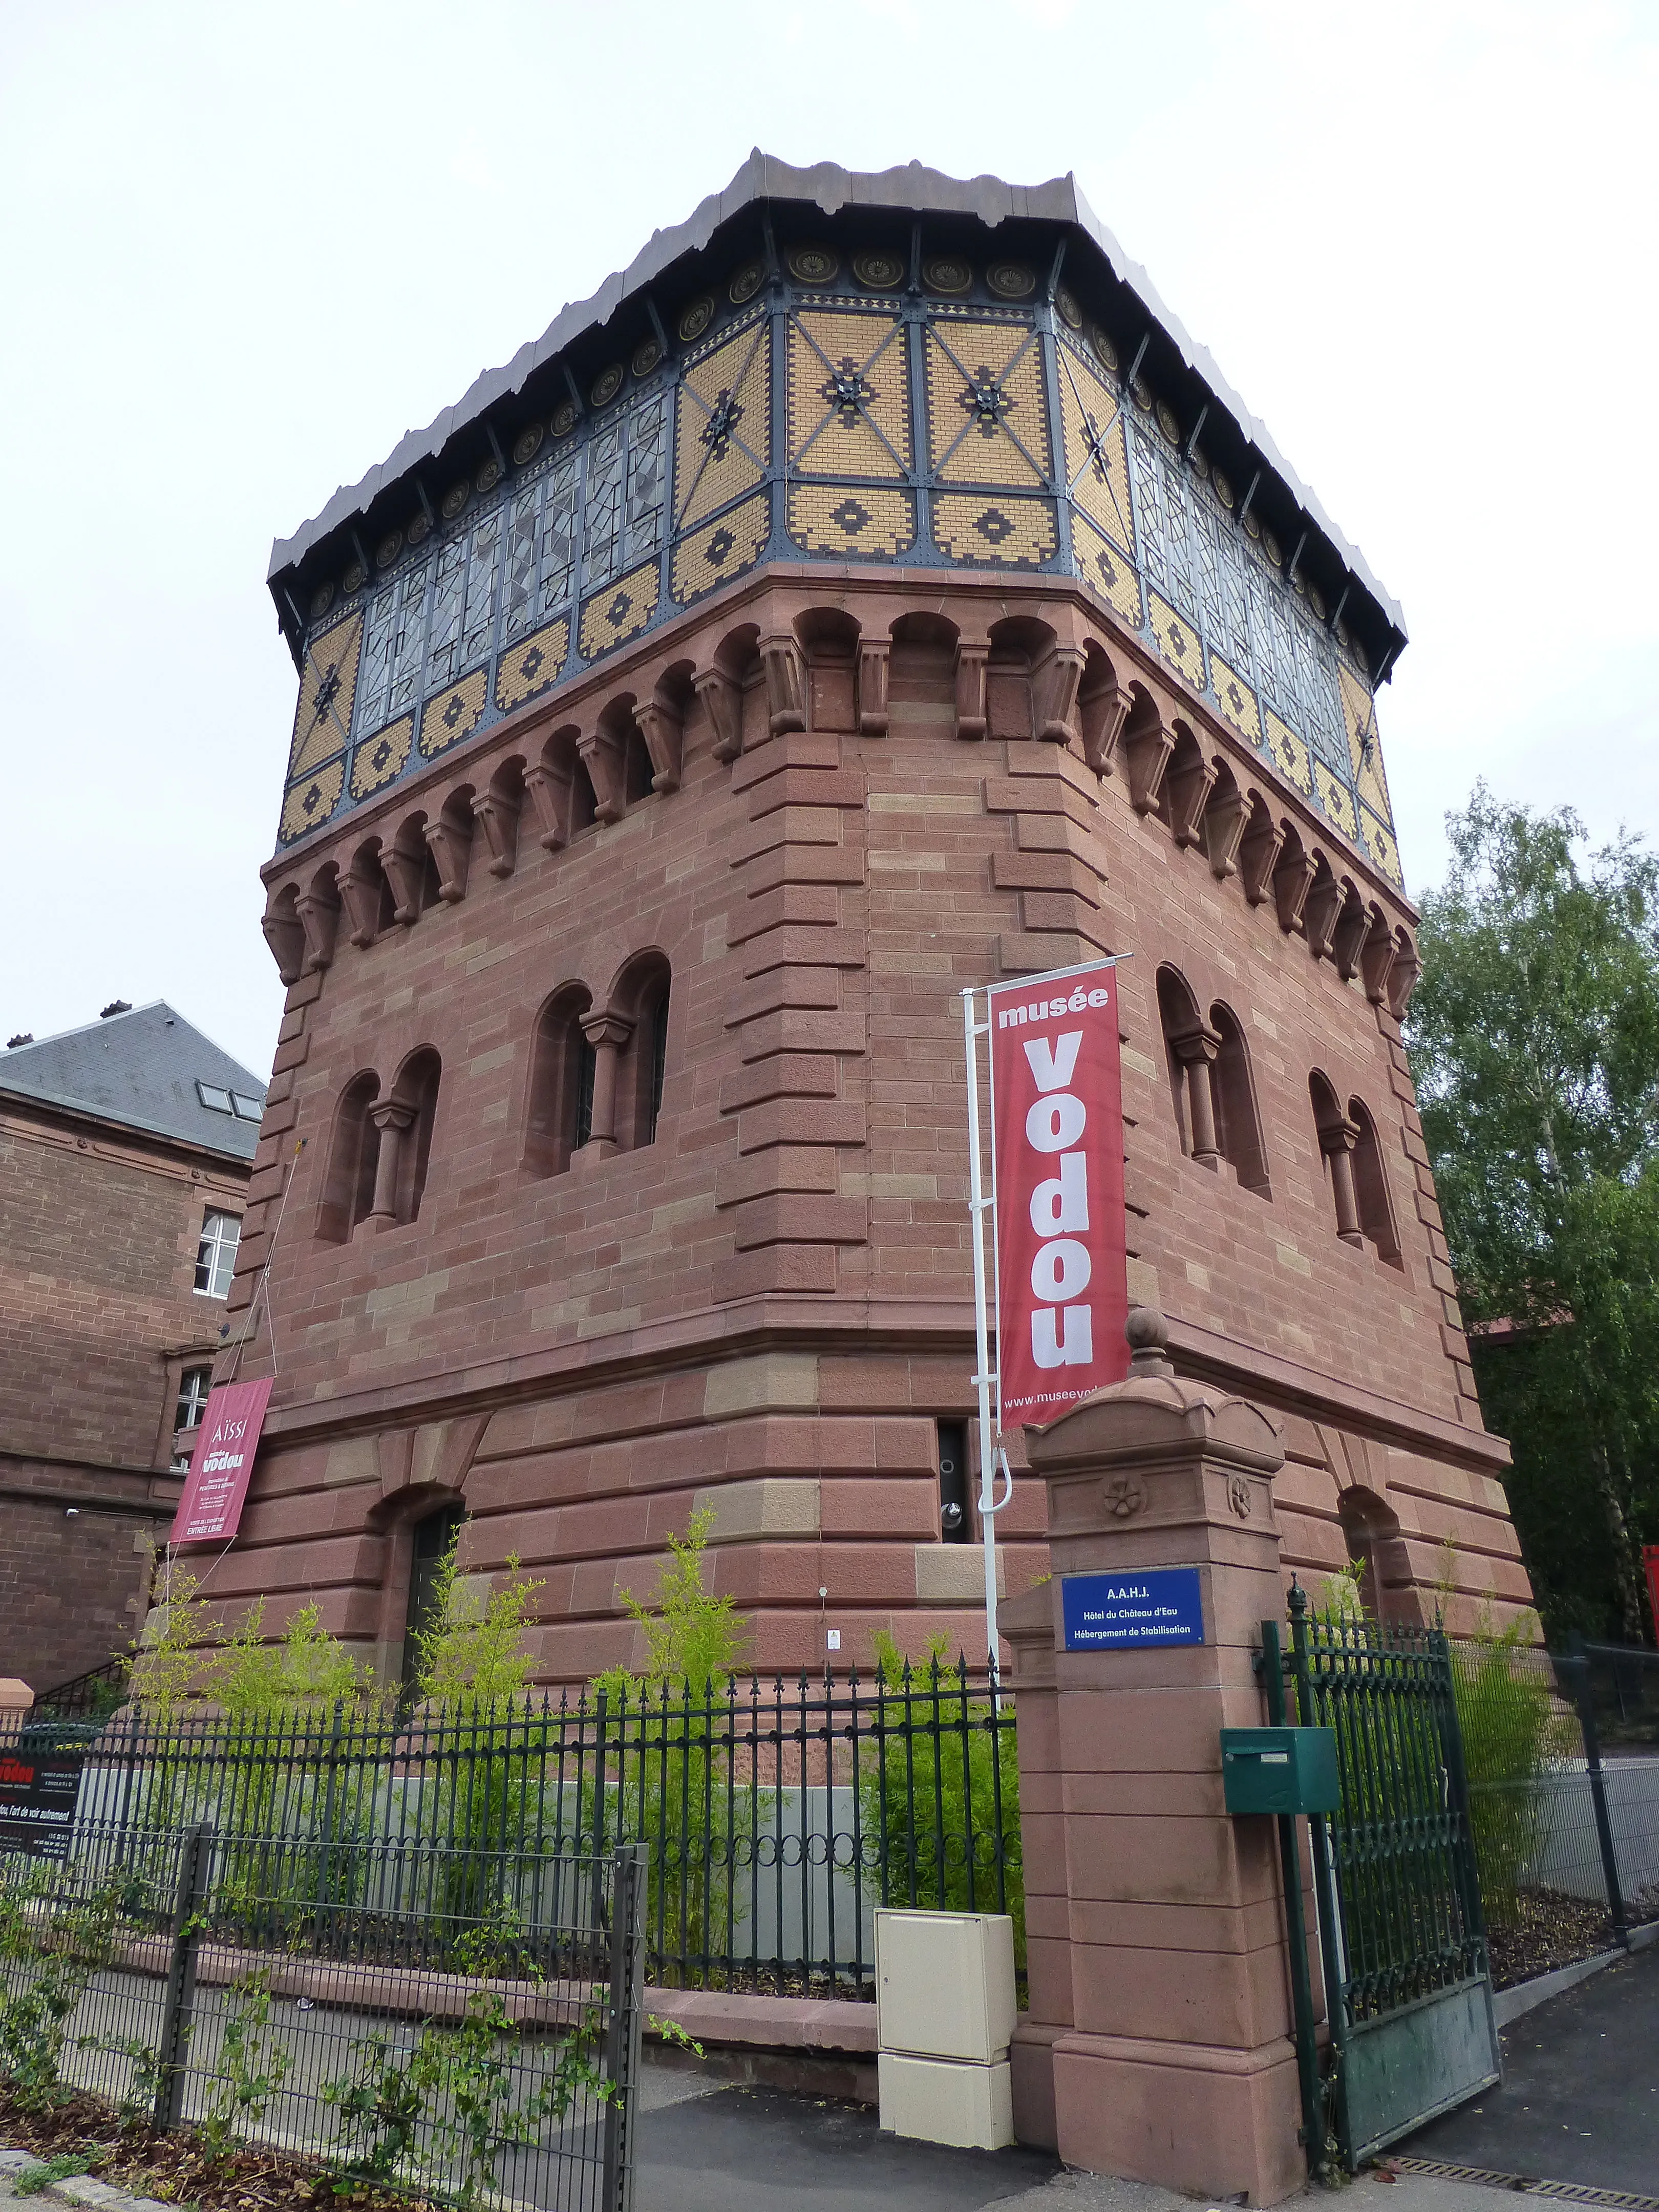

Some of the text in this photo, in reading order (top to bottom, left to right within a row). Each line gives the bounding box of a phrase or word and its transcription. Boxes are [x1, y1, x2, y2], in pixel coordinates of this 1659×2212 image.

[999, 985, 1109, 1029] musée
[1023, 1030, 1093, 1368] vodou
[203, 1452, 244, 1473] vodou
[1107, 1586, 1149, 1600] A.A.H.J.
[1083, 1607, 1177, 1620] Hôtel du Château d'Eau
[1074, 1625, 1190, 1639] Hébergement de Stabilisation
[39, 1809, 70, 1821] autrement
